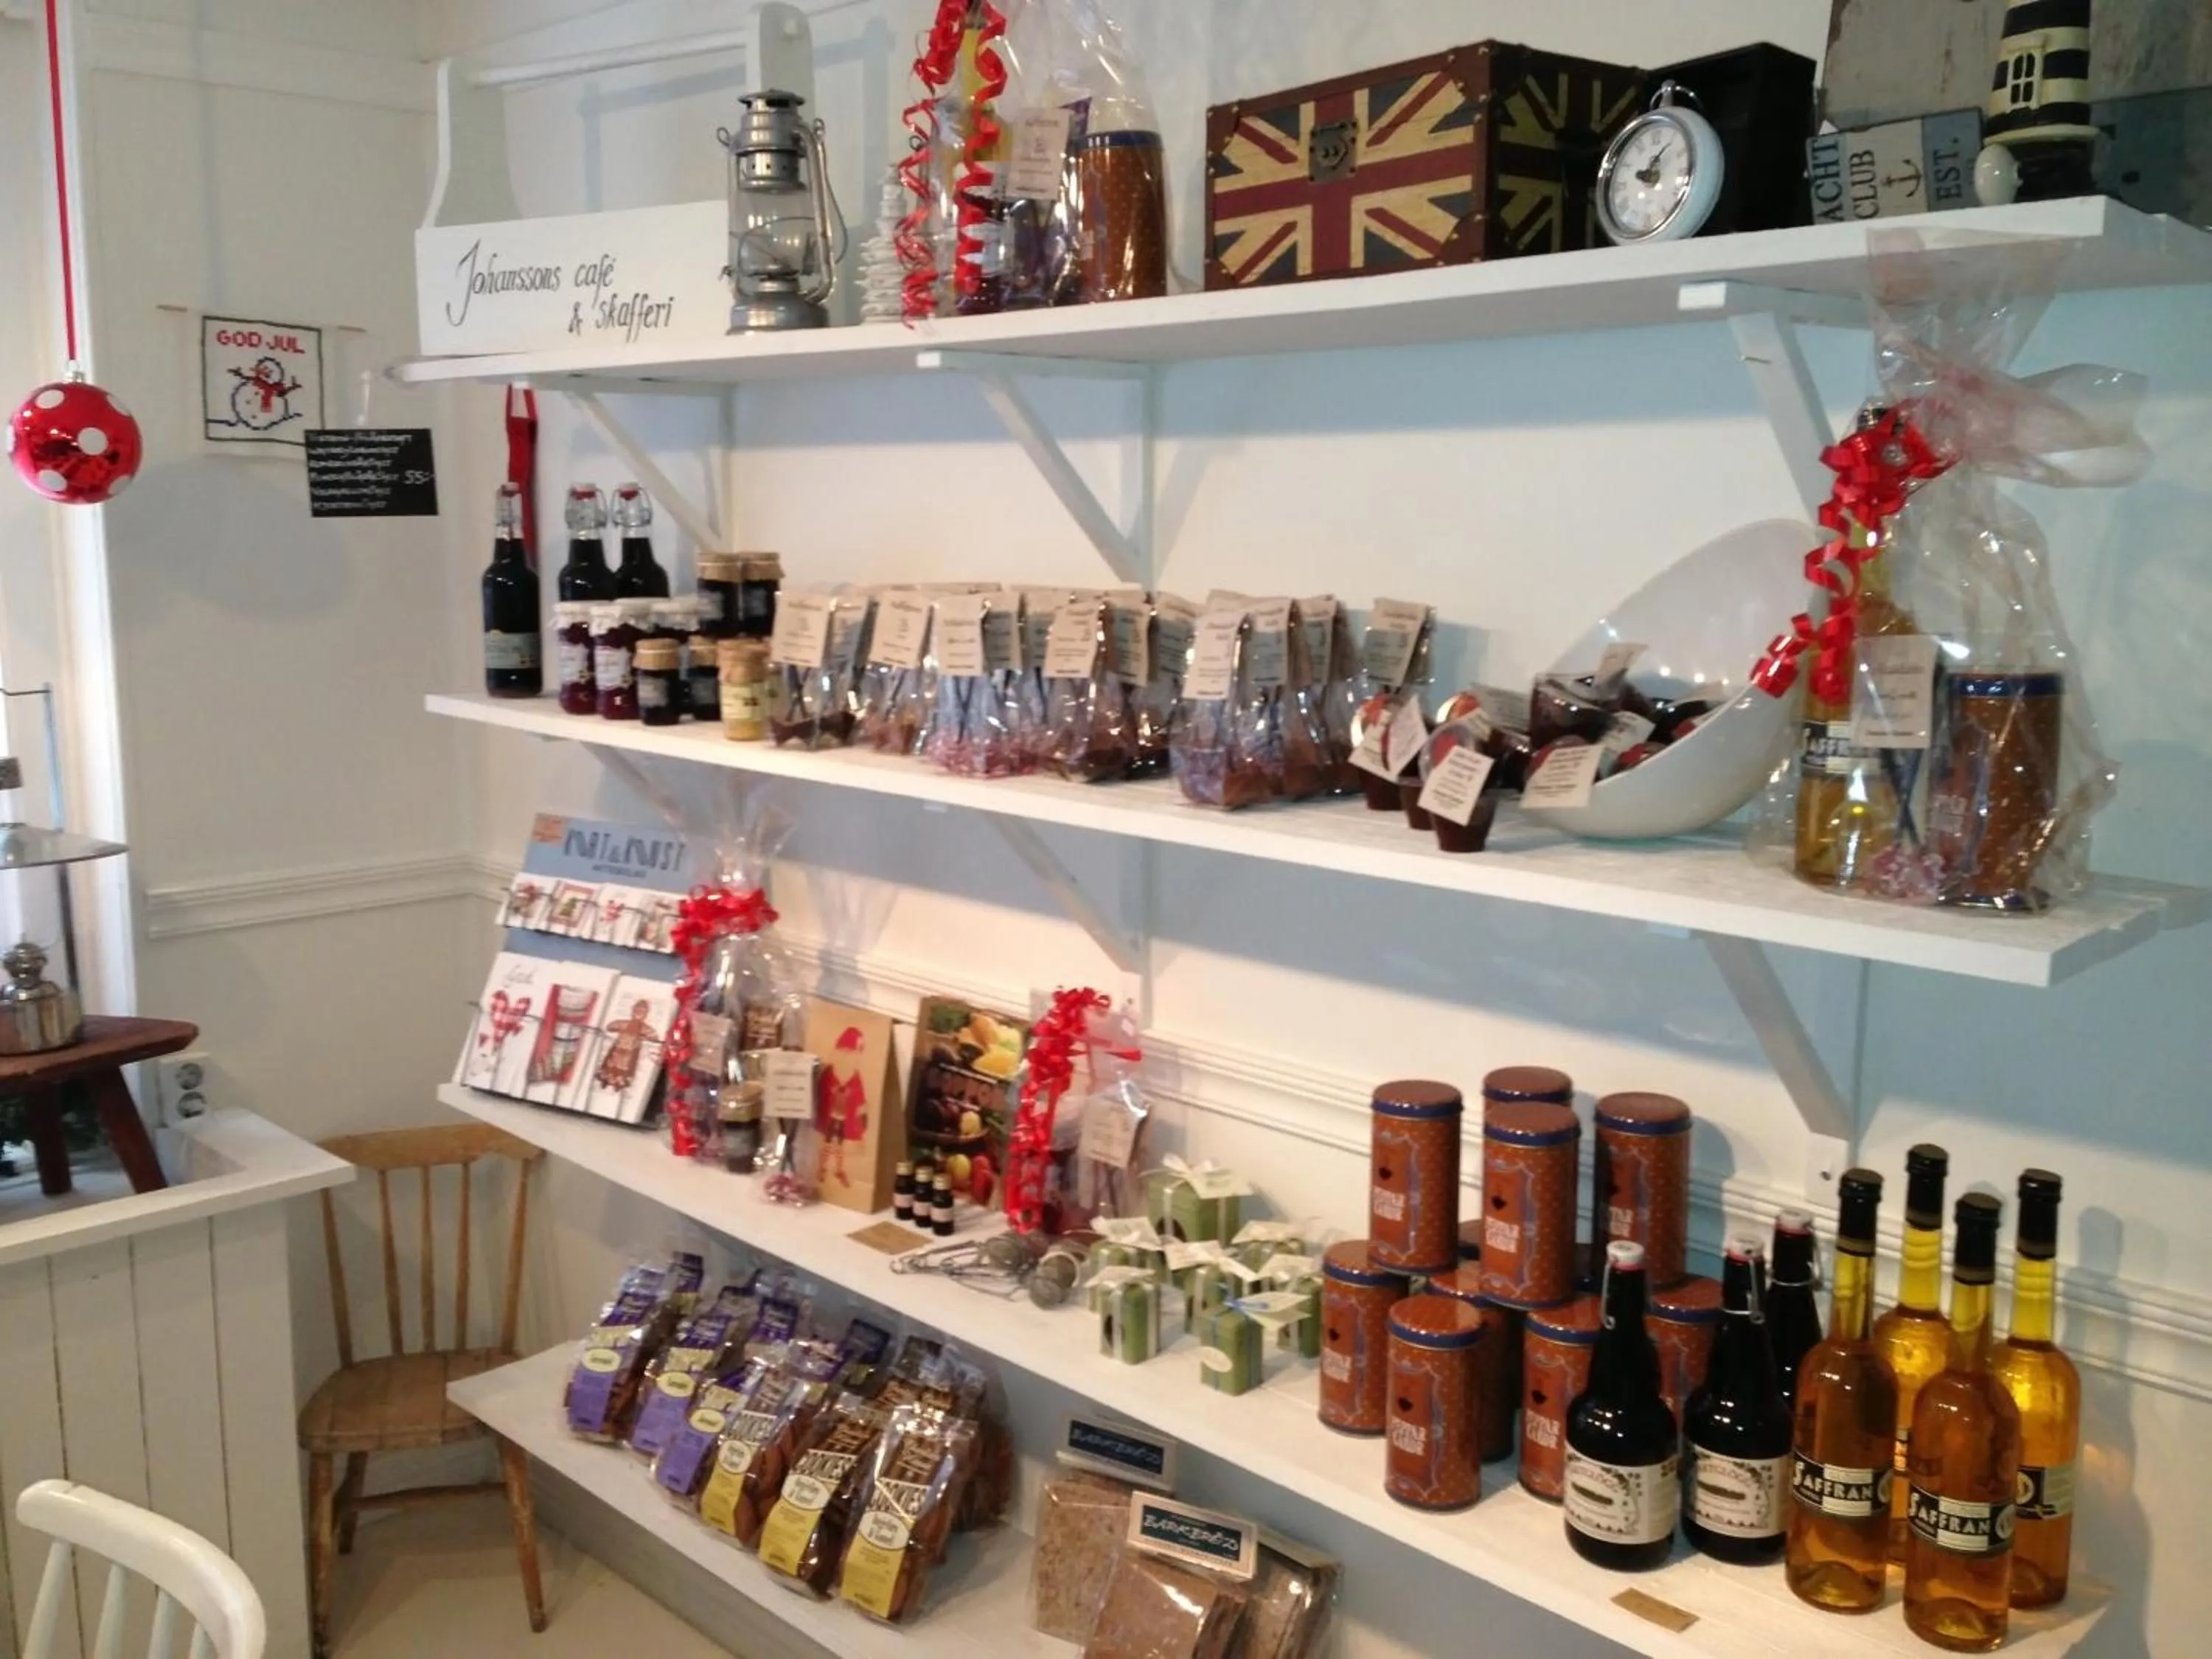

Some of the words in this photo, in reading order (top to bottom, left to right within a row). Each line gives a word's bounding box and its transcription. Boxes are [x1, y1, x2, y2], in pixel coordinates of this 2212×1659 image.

[1812, 137, 1844, 220] ACHT
[1849, 150, 1879, 219] CLUB
[1933, 137, 1962, 201] EST.
[446, 239, 561, 327] Johanssons
[574, 254, 616, 310] café
[216, 330, 262, 348] GOD
[266, 335, 305, 354] JUL
[1792, 1461, 1873, 1499] SAFFRAN
[1909, 1492, 1990, 1534] SAFFRAN
